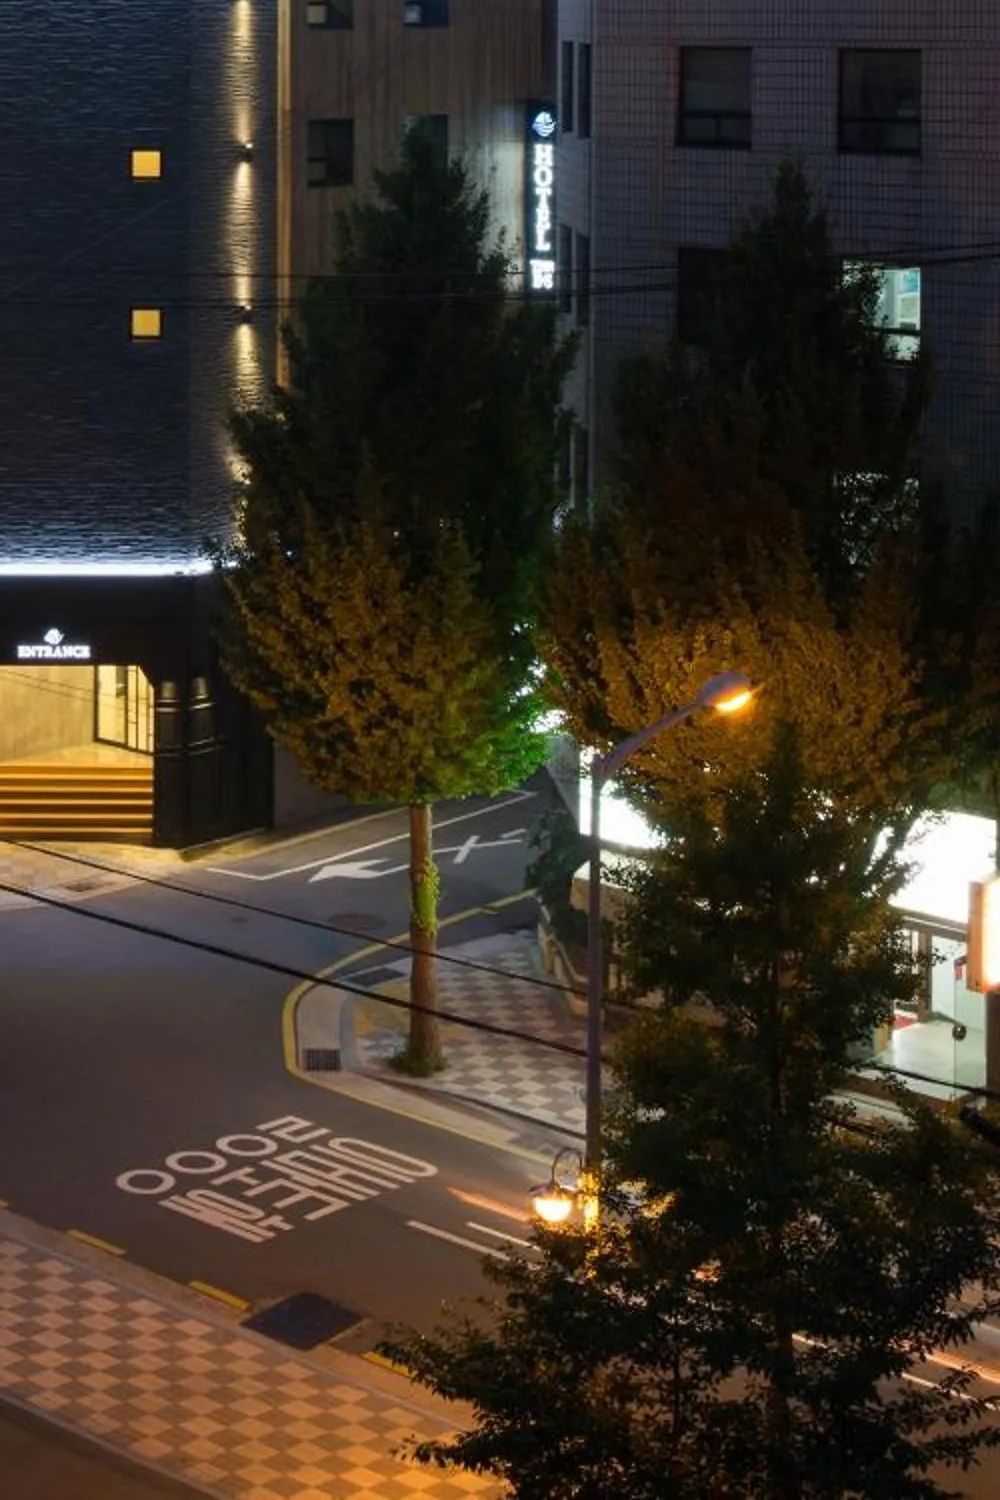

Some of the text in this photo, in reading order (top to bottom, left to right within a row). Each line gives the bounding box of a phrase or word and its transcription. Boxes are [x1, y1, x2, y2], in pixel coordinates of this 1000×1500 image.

[533, 143, 553, 252] HOTEL
[17, 645, 91, 659] ENTRANCE
[115, 1114, 439, 1244] 일방통행
